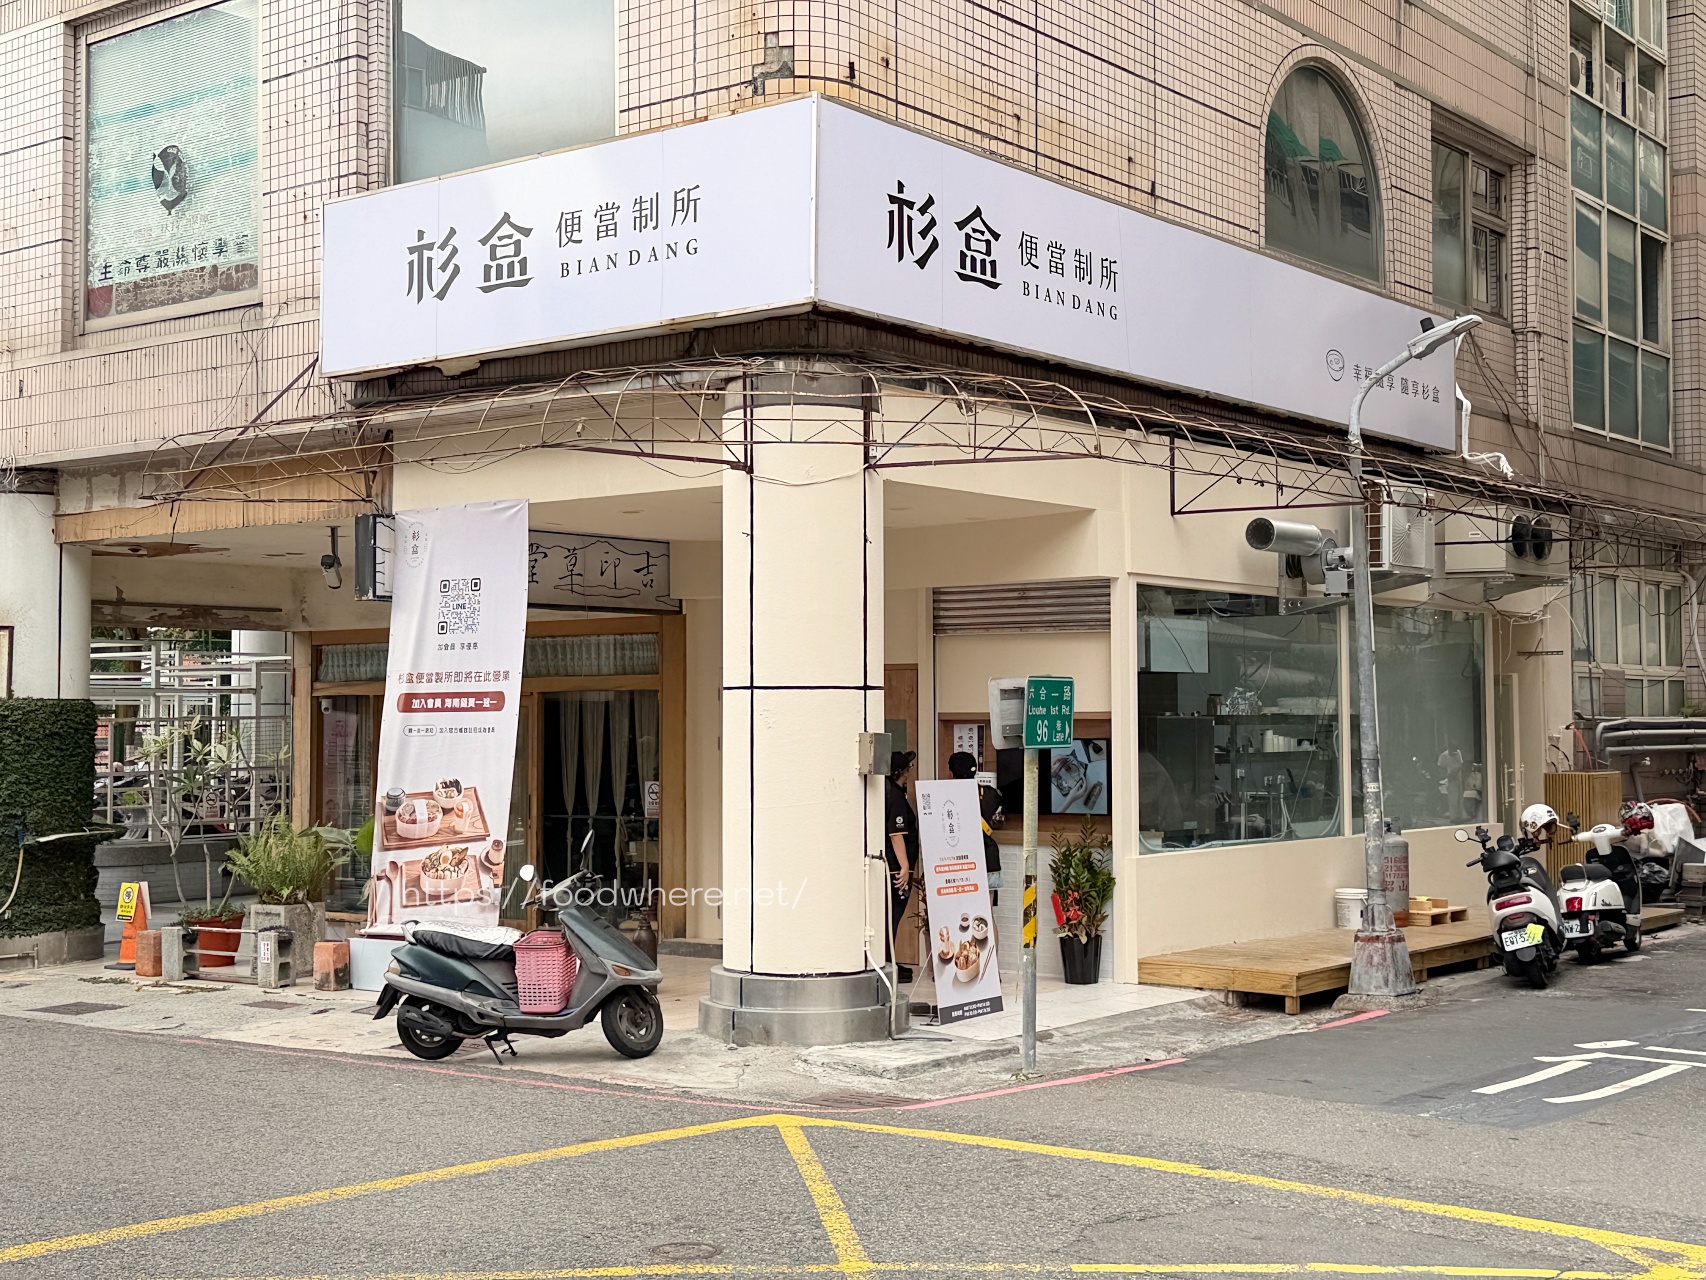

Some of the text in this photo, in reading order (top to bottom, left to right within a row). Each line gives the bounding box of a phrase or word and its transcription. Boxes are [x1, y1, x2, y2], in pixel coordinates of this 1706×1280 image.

[406, 184, 701, 305] 杉盒 便當制所
[886, 179, 1118, 293] 杉盒 便當制所
[1029, 685, 1072, 701] 六合一路
[1036, 719, 1049, 743] 96
[1052, 730, 1065, 742] Lane
